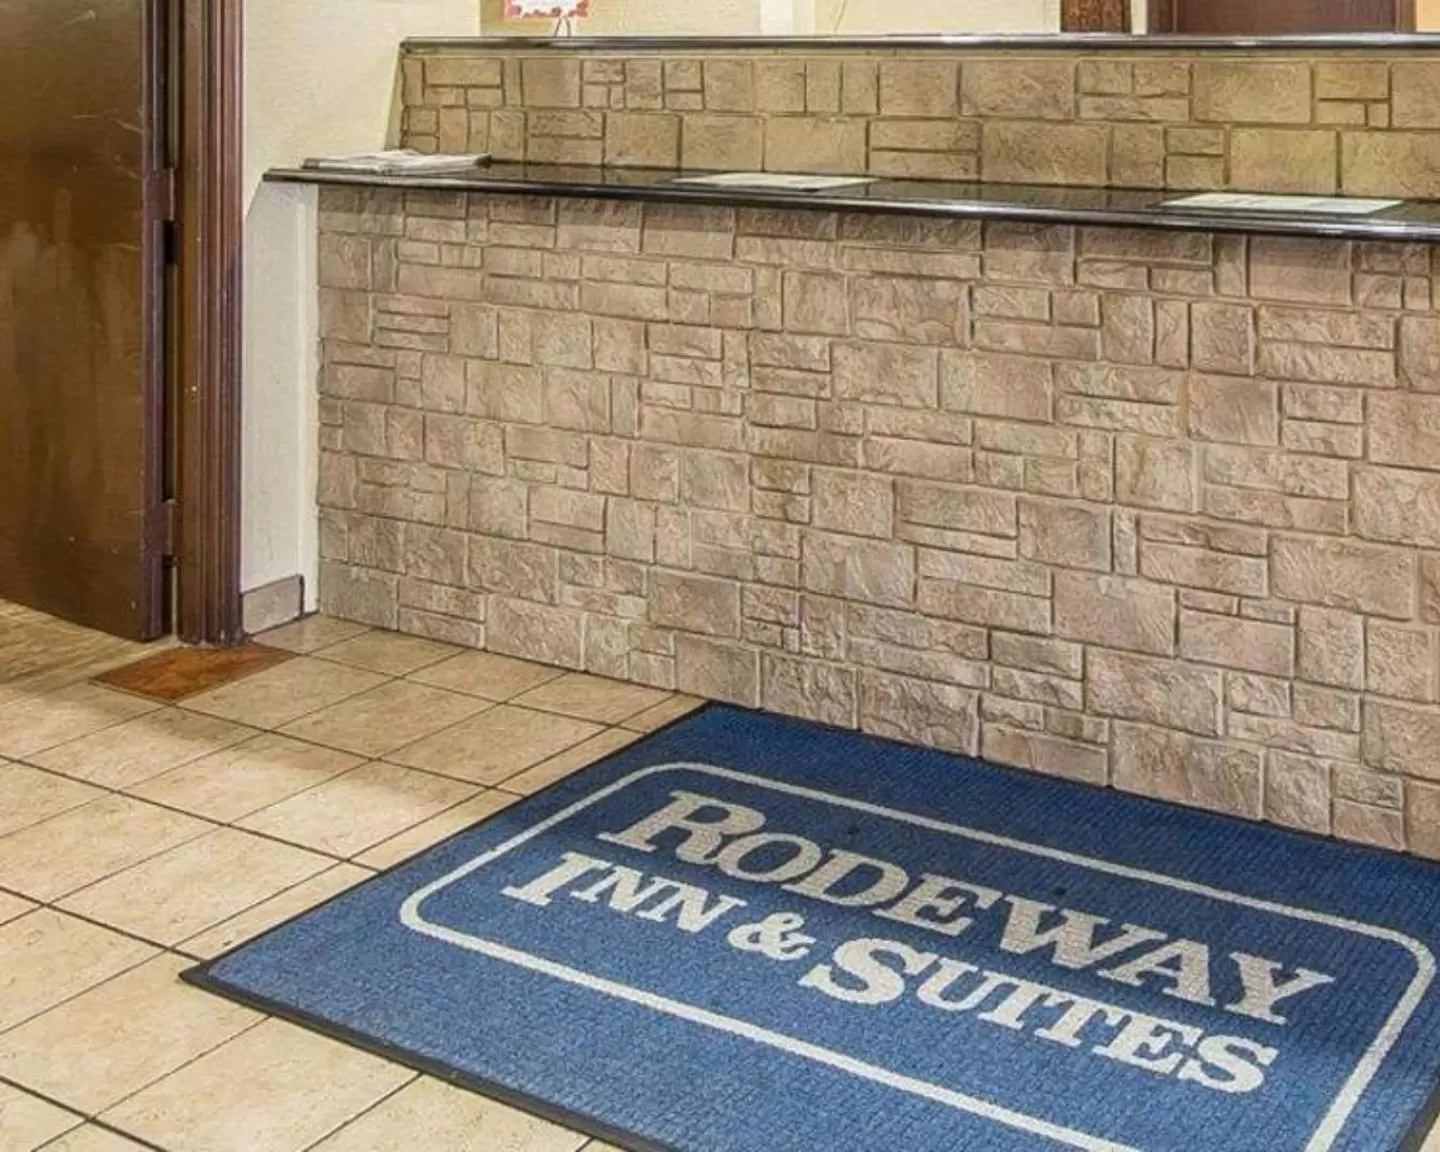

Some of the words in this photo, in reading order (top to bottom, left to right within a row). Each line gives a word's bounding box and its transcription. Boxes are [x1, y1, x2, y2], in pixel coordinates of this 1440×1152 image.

[501, 852, 748, 933] INN
[727, 909, 818, 960] &
[799, 937, 1278, 1094] SUITES
[597, 790, 1334, 1025] RODEWAY
